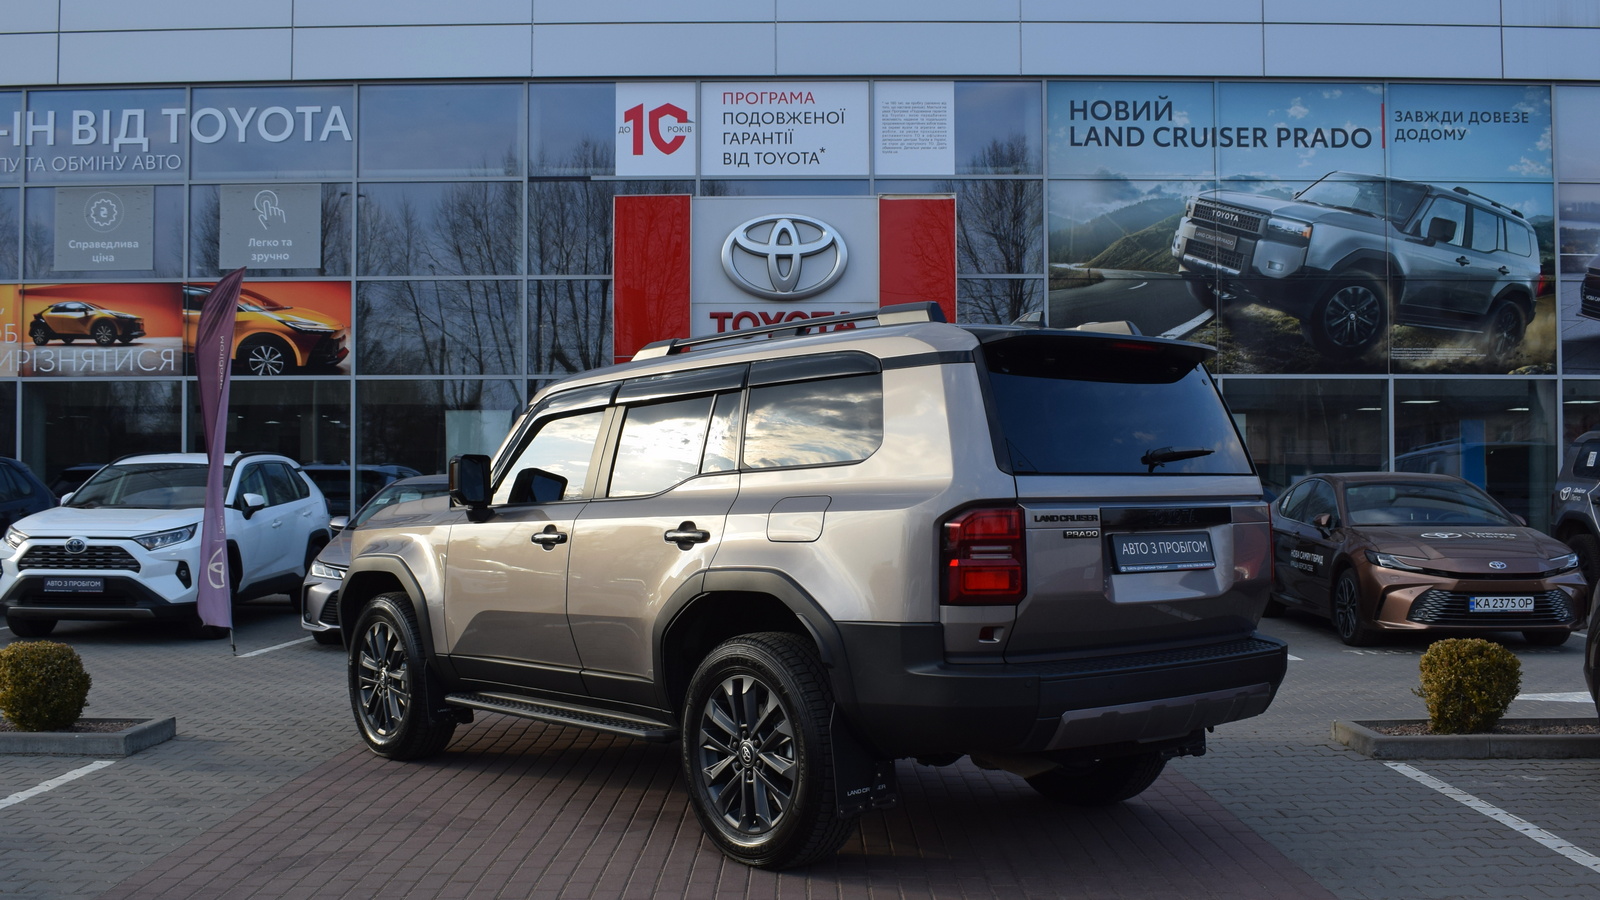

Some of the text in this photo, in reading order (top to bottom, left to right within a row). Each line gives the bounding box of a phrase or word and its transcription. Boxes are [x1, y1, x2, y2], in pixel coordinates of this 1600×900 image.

[723, 91, 815, 105] ПРОГРАМА
[1069, 96, 1173, 122] НОВИЙ
[723, 108, 847, 127] ПОДОВЖЕНОЇ
[1394, 110, 1529, 125] ЗАВЖДИ ДОВЕЗЕ
[72, 109, 149, 152] ВІД
[161, 105, 352, 144] TOYOTA
[618, 126, 631, 134] ДО
[667, 125, 692, 133] РОКІВ
[1394, 127, 1466, 143] ДОДОМУ
[723, 128, 796, 145] ГАРАНТІЇ
[1069, 126, 1372, 149] LAND CRUISER PRADO
[26, 156, 46, 172] ТА
[52, 155, 128, 171] ОБМІНУ
[131, 153, 181, 170] АВТО
[723, 151, 750, 167] ВІД
[1212, 210, 1239, 222] TOYOTA
[68, 239, 139, 250] Справедлива
[248, 237, 293, 248] Легко та
[92, 253, 115, 264] ціна
[251, 251, 290, 262] зручно
[0, 323, 18, 344] Б
[1059, 514, 1098, 522] CRUISER
[1066, 530, 1098, 538] PRADO
[1122, 542, 1149, 555] АВТО
[1159, 540, 1208, 554] ПРОБІГОМ
[1475, 598, 1533, 608] KA 2375 OP
[847, 788, 862, 796] LAND
